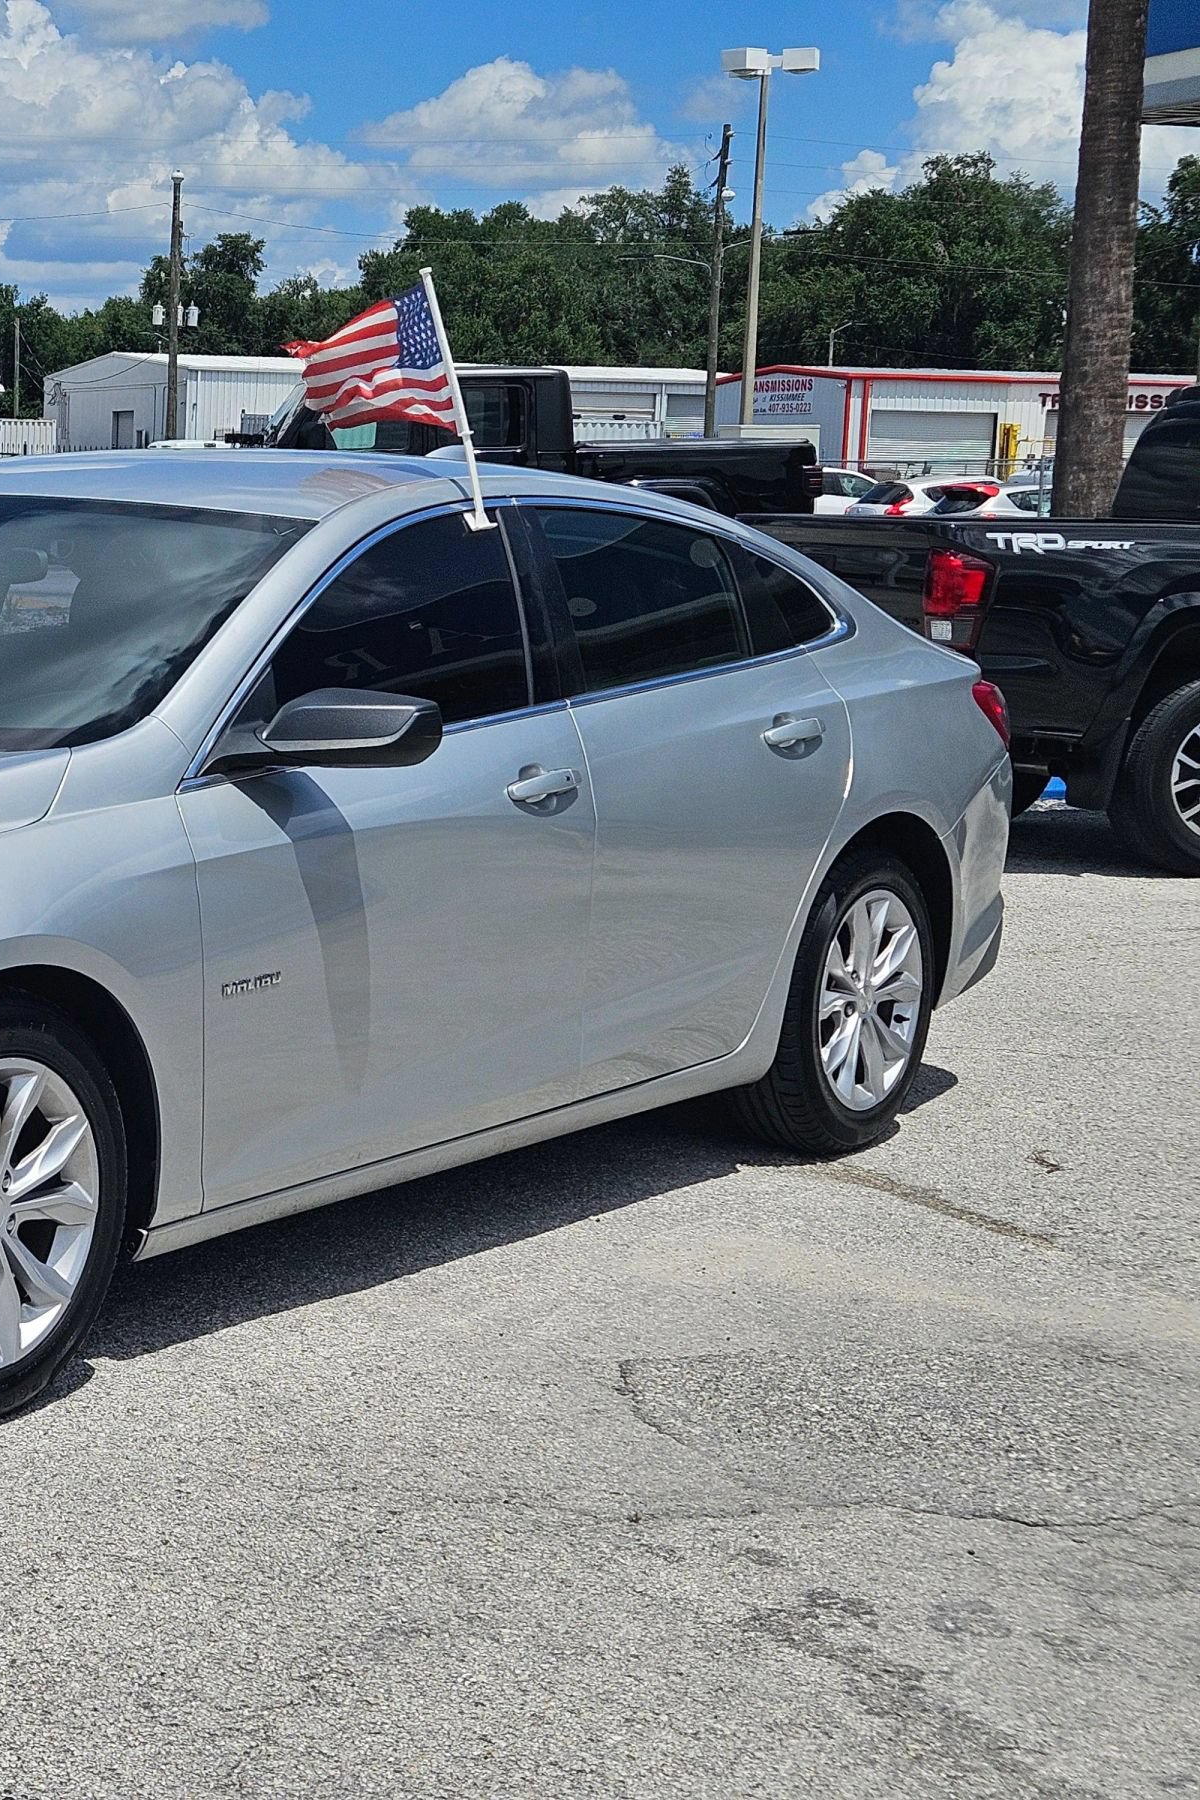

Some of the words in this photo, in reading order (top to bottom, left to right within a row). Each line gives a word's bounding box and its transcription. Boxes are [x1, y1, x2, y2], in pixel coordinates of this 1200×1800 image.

[753, 379, 813, 393] ANSMISSIONS
[769, 393, 806, 402] KISSIMMEE
[768, 402, 812, 413] 407-935-0223
[985, 532, 1067, 555] TRD
[1066, 540, 1135, 550] SPORT
[221, 970, 282, 998] MALIBU
